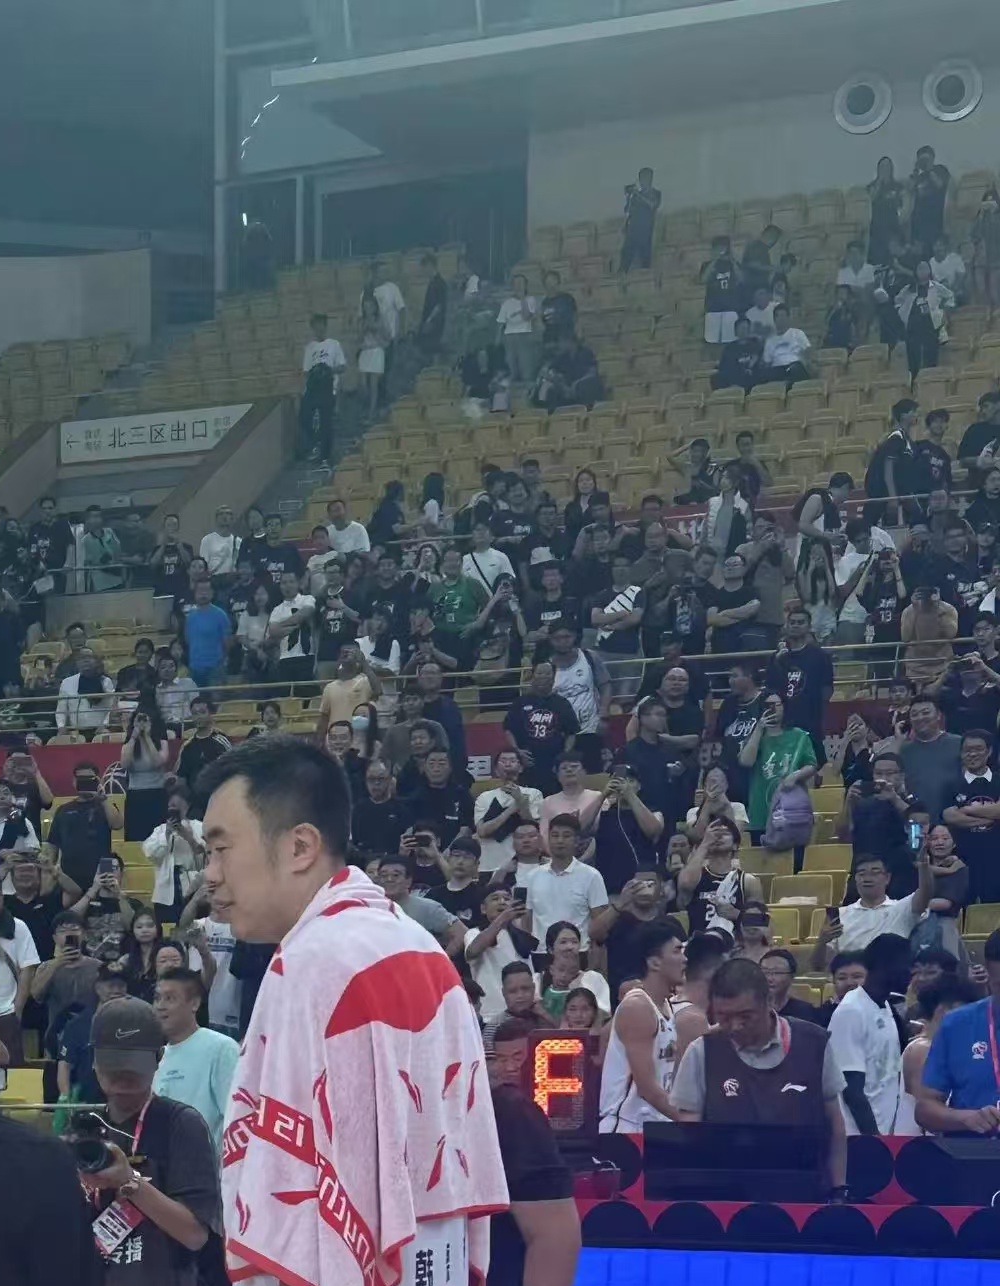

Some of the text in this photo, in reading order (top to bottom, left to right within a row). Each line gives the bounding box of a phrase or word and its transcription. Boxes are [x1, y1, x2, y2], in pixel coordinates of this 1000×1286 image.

[108, 419, 208, 448] 北三区出口
[533, 724, 546, 738] 13
